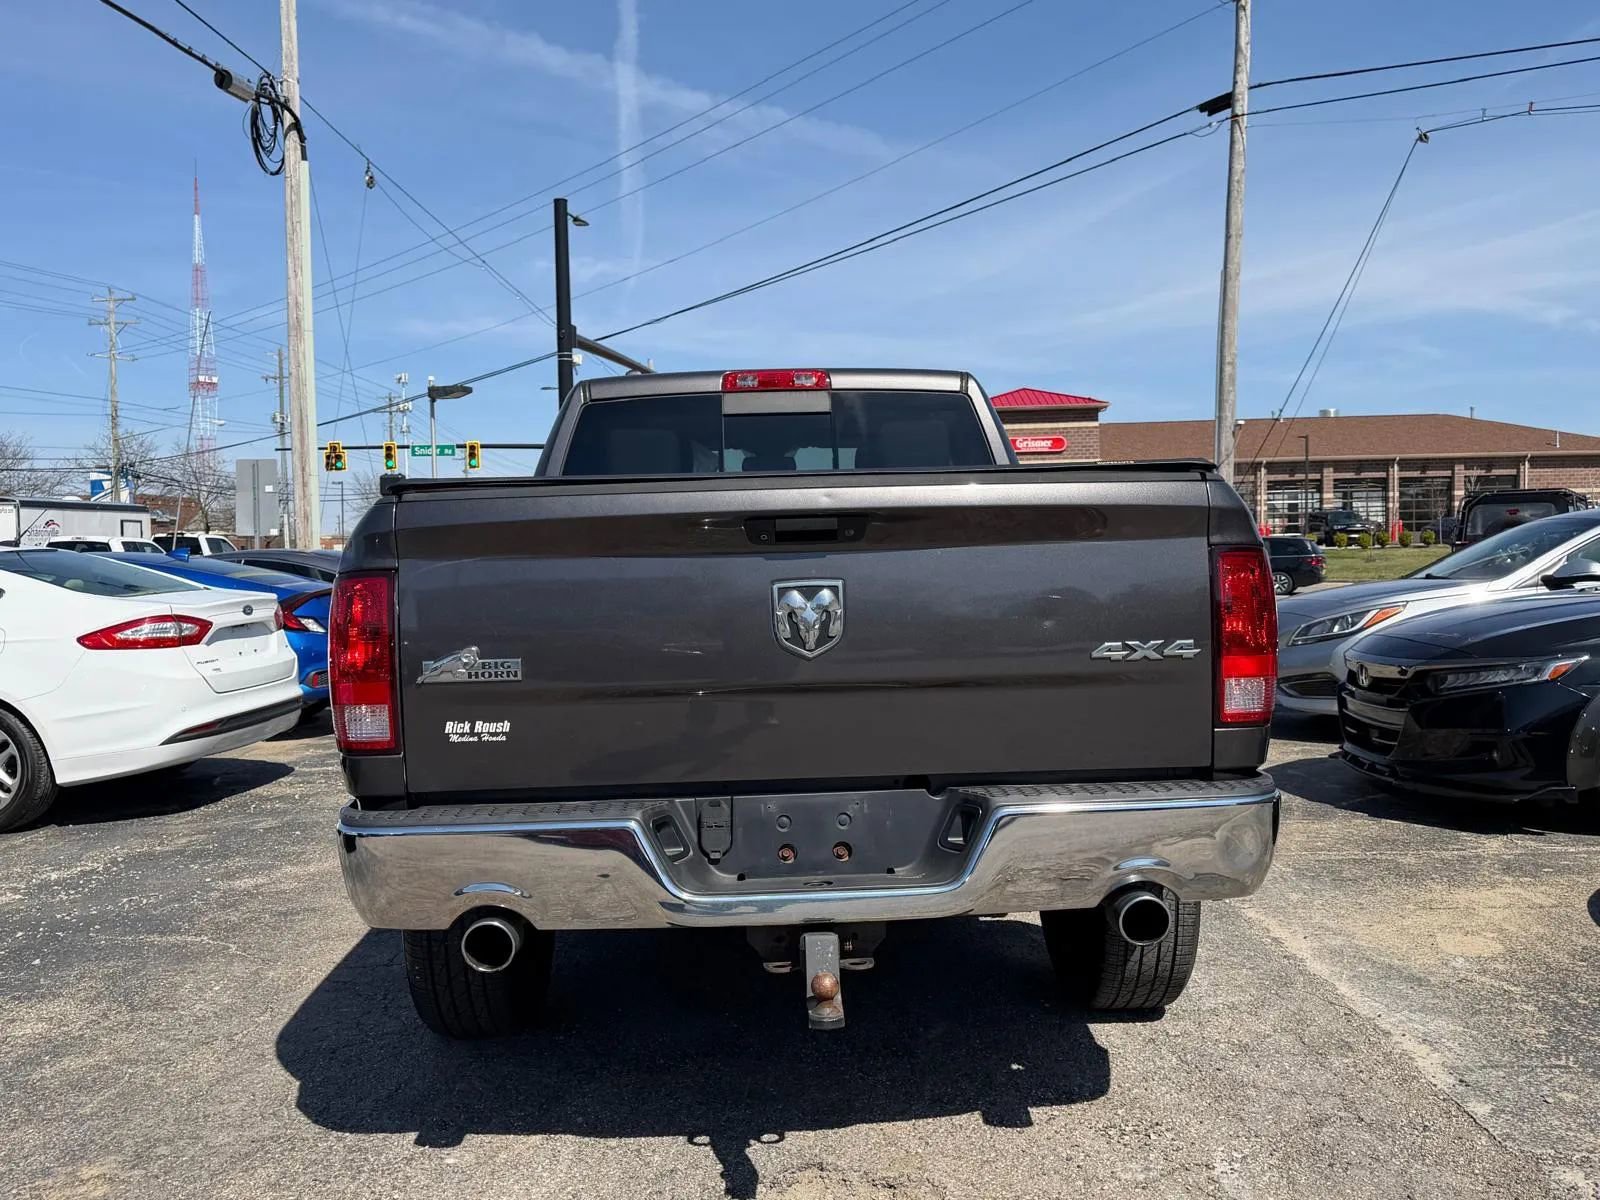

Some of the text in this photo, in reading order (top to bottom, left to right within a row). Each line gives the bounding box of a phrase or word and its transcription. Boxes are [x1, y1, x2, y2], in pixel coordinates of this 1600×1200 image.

[1015, 439, 1053, 448] Grismer
[414, 446, 440, 455] Snidr
[481, 661, 512, 669] BIG
[467, 670, 518, 679] HORN
[444, 719, 511, 734] Rick Roush
[448, 733, 507, 743] Medina Honda
